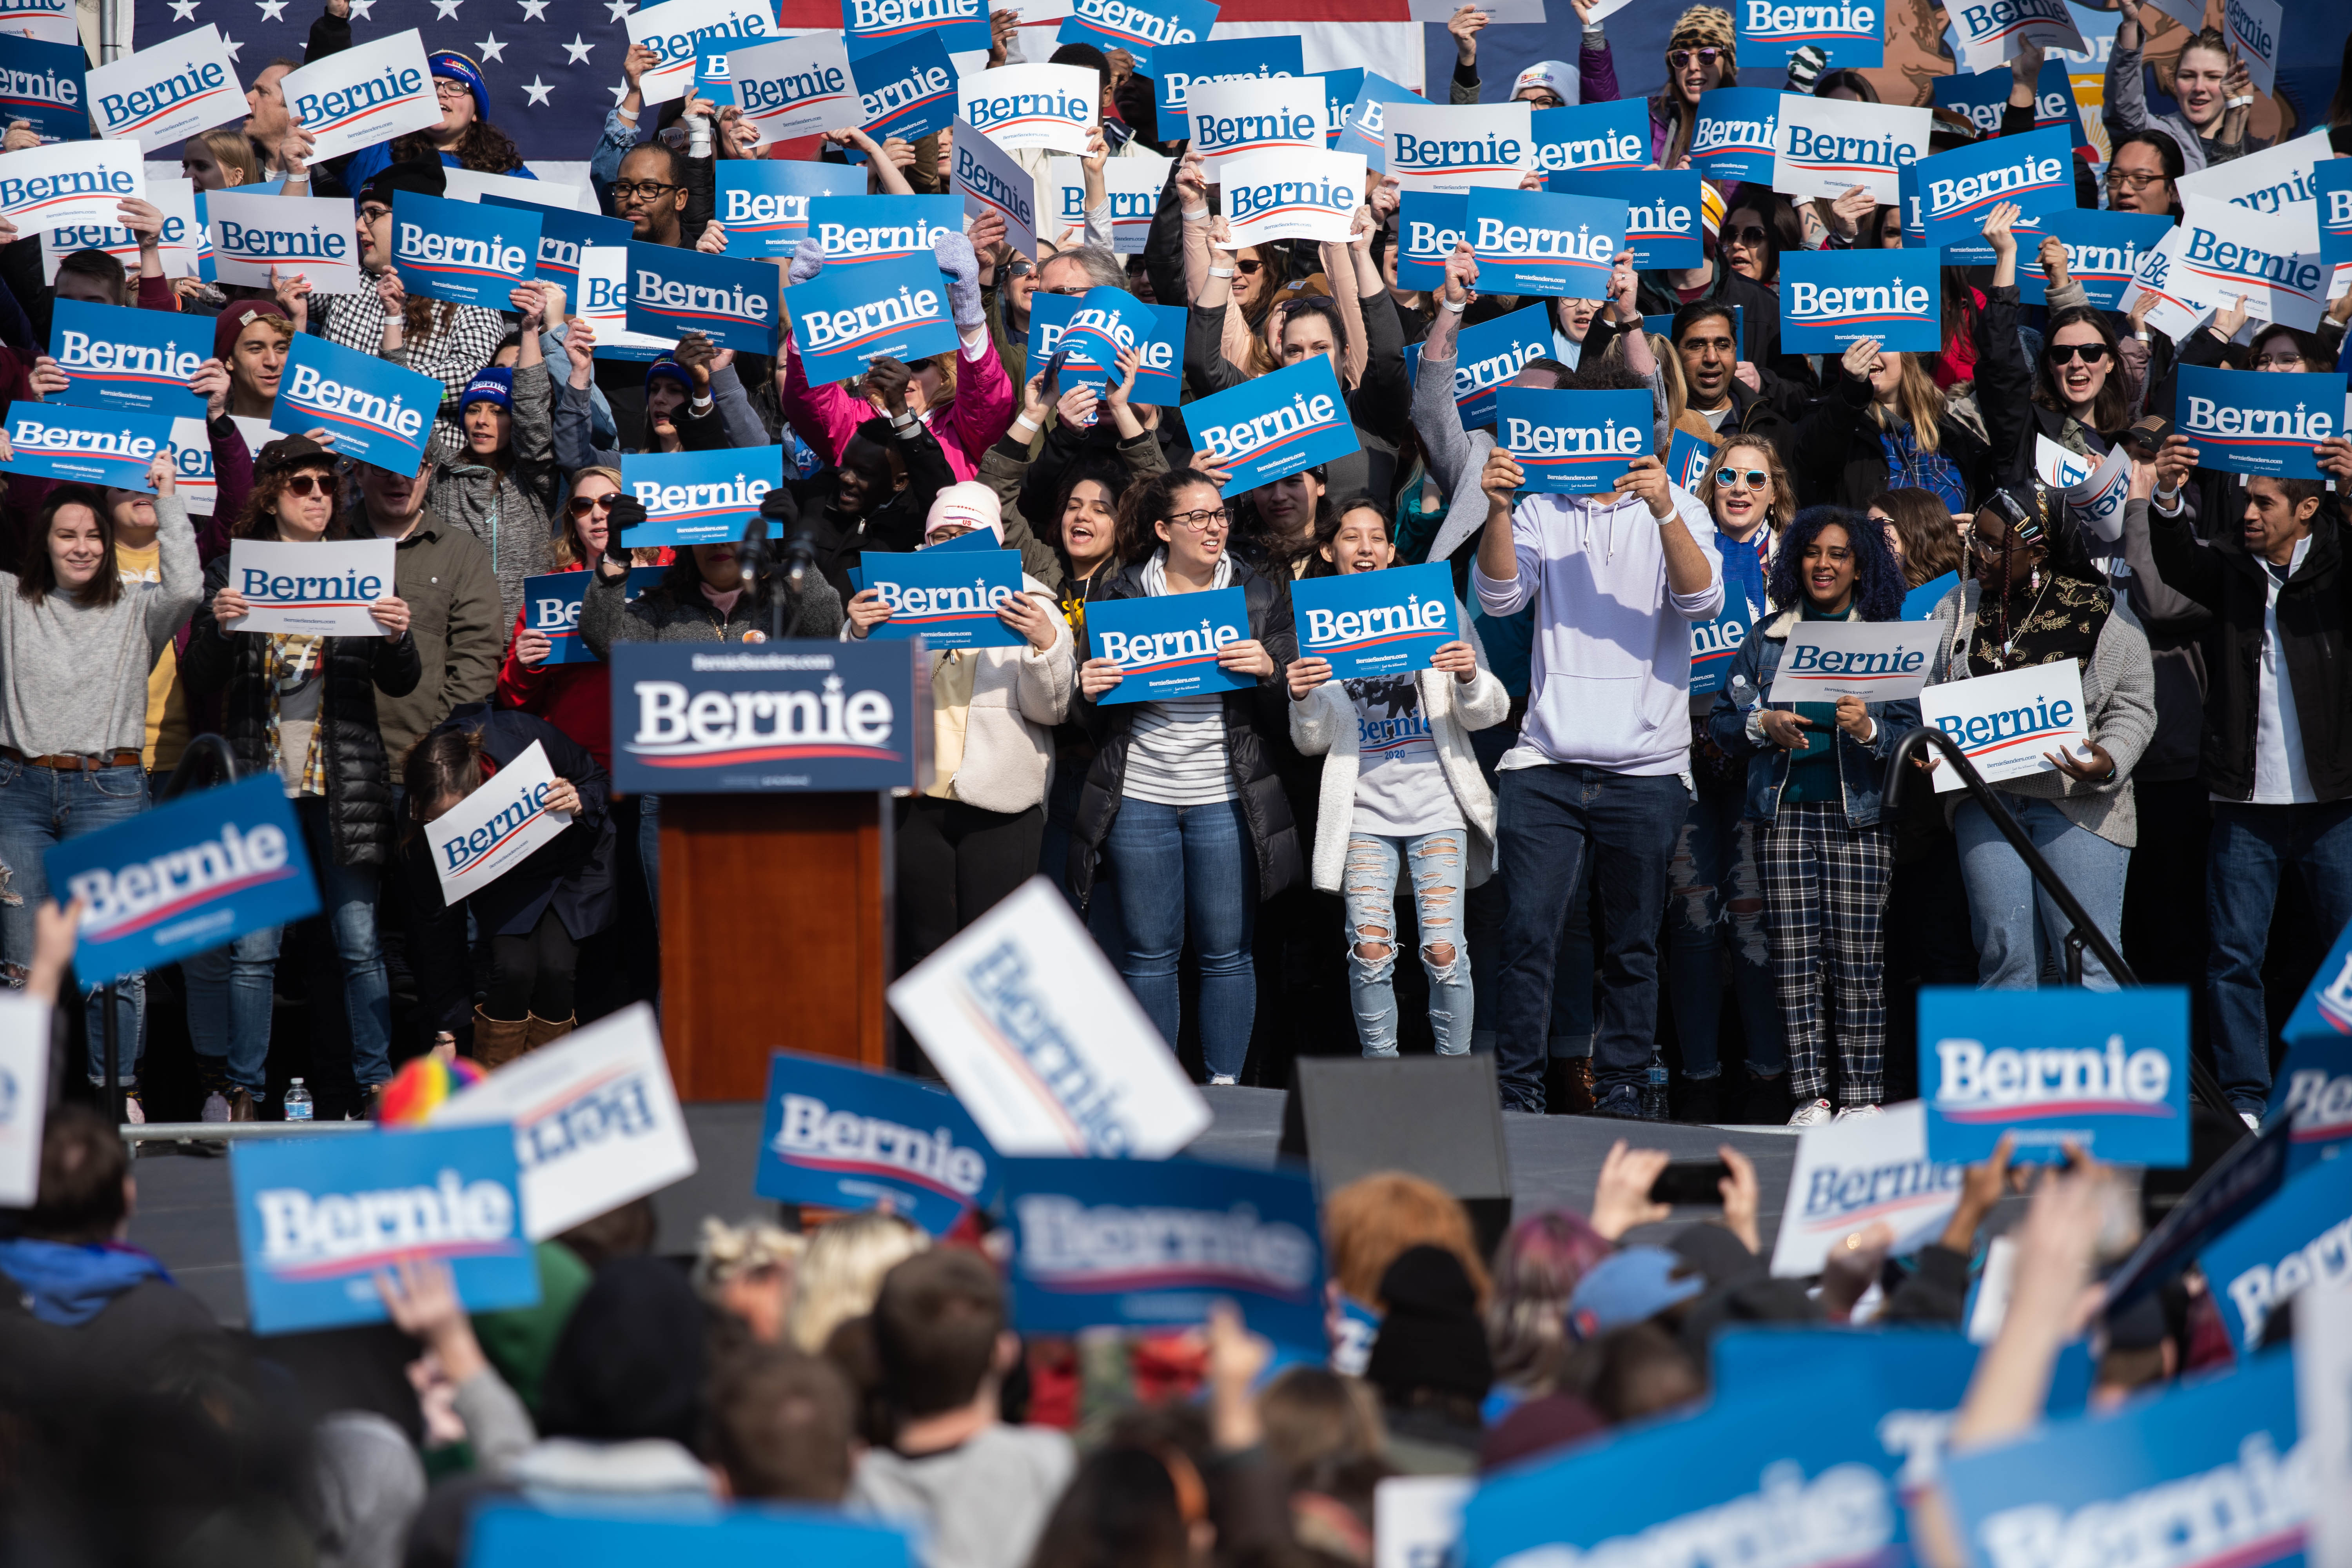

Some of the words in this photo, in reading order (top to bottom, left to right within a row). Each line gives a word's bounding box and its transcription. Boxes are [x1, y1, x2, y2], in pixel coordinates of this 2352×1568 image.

[852, 0, 979, 28] Bernie
[1074, 0, 1196, 44] Bernie
[1746, 0, 1875, 33] Bernie
[1961, 0, 2068, 36] Bernie
[2227, 0, 2272, 58] Bernie
[0, 67, 78, 105] rnie
[98, 61, 225, 127] Bernie
[739, 61, 845, 110] Bernie
[860, 65, 950, 120] ernie
[1521, 72, 1553, 81] Bernie
[296, 65, 422, 126] Bernie
[967, 88, 1088, 125] Bernie
[1947, 90, 2067, 131] Berie
[154, 116, 199, 135] BernieSanders.com
[347, 121, 392, 138] BernieSanders.com
[782, 116, 822, 127] BernieSanders.com
[886, 118, 927, 137] BernieSanders.com
[1196, 105, 1315, 146] Bernie
[1394, 131, 1520, 165] Bernie
[1787, 125, 1916, 166] Bernie
[0, 163, 134, 208] Bernie
[957, 145, 1031, 225] Bernie
[1062, 184, 1160, 215] Brni
[1230, 175, 1354, 217] Bernie
[1929, 154, 2062, 212] Bernie
[46, 210, 96, 218] BernieSanders.com
[726, 188, 809, 221] Ber
[1627, 196, 1691, 233] nie
[52, 216, 185, 247] Bere
[219, 221, 345, 259] Bernie
[819, 218, 950, 254] Bernie
[1264, 222, 1311, 230] BernieSanders.com
[1475, 217, 1613, 262] Bernie
[399, 222, 526, 274] Bernie
[2067, 240, 2149, 273] erni
[2185, 227, 2321, 291] Bernie
[432, 280, 478, 294] BernieSanders.com
[1515, 274, 1566, 283] BernieSanders.com
[1791, 276, 1929, 314] Bernie
[636, 283, 768, 319] Bernie
[801, 285, 939, 346] Bernie
[2218, 289, 2267, 307] BernieSaers.com
[1069, 309, 1134, 350] rnie
[59, 330, 202, 380] Bernie
[858, 345, 907, 361] BernieSanders.com
[1455, 340, 1545, 394] ernie
[100, 390, 152, 401] BernieSanders.com
[288, 363, 422, 437] Bernie
[472, 380, 507, 394] Bernie
[1200, 392, 1335, 459] Bernie
[1507, 417, 1642, 454] Bernie
[2187, 396, 2333, 439] Bernie
[13, 420, 155, 458] Bernie
[323, 429, 369, 448] ernieSanders.com
[51, 463, 104, 474] BernieSanders.com
[1257, 452, 1305, 472] BernieSanders.com
[2229, 454, 2283, 465] BernieSanders.com
[633, 473, 771, 511] Bernie
[2081, 468, 2130, 522] Ber
[242, 568, 381, 600] Bernie
[874, 577, 1013, 611] Bernie
[1305, 593, 1446, 643] Bernie
[1690, 619, 1744, 651] nie
[1100, 618, 1239, 663] Bernie
[1355, 653, 1408, 664] BernieSanders.com
[1789, 644, 1924, 673] Bernie
[692, 652, 834, 671] BernieSanders.com
[1690, 674, 1714, 682] nders.com
[1149, 676, 1200, 687] BernieSanders.com
[634, 673, 894, 746] Bernie
[1359, 708, 1431, 742] Bernie
[1935, 694, 2073, 747] Bernie
[1385, 750, 1405, 759] 2020
[1987, 755, 2036, 769] BernieSanders.com
[443, 781, 550, 871] Bernie
[69, 819, 290, 924] Bernie
[489, 838, 529, 869] BernieSanders.com
[1936, 1034, 2171, 1104] Bernie
[775, 1093, 987, 1198] Bernie
[256, 1168, 517, 1263] Bernie
[1017, 1193, 1319, 1290] Bernie
